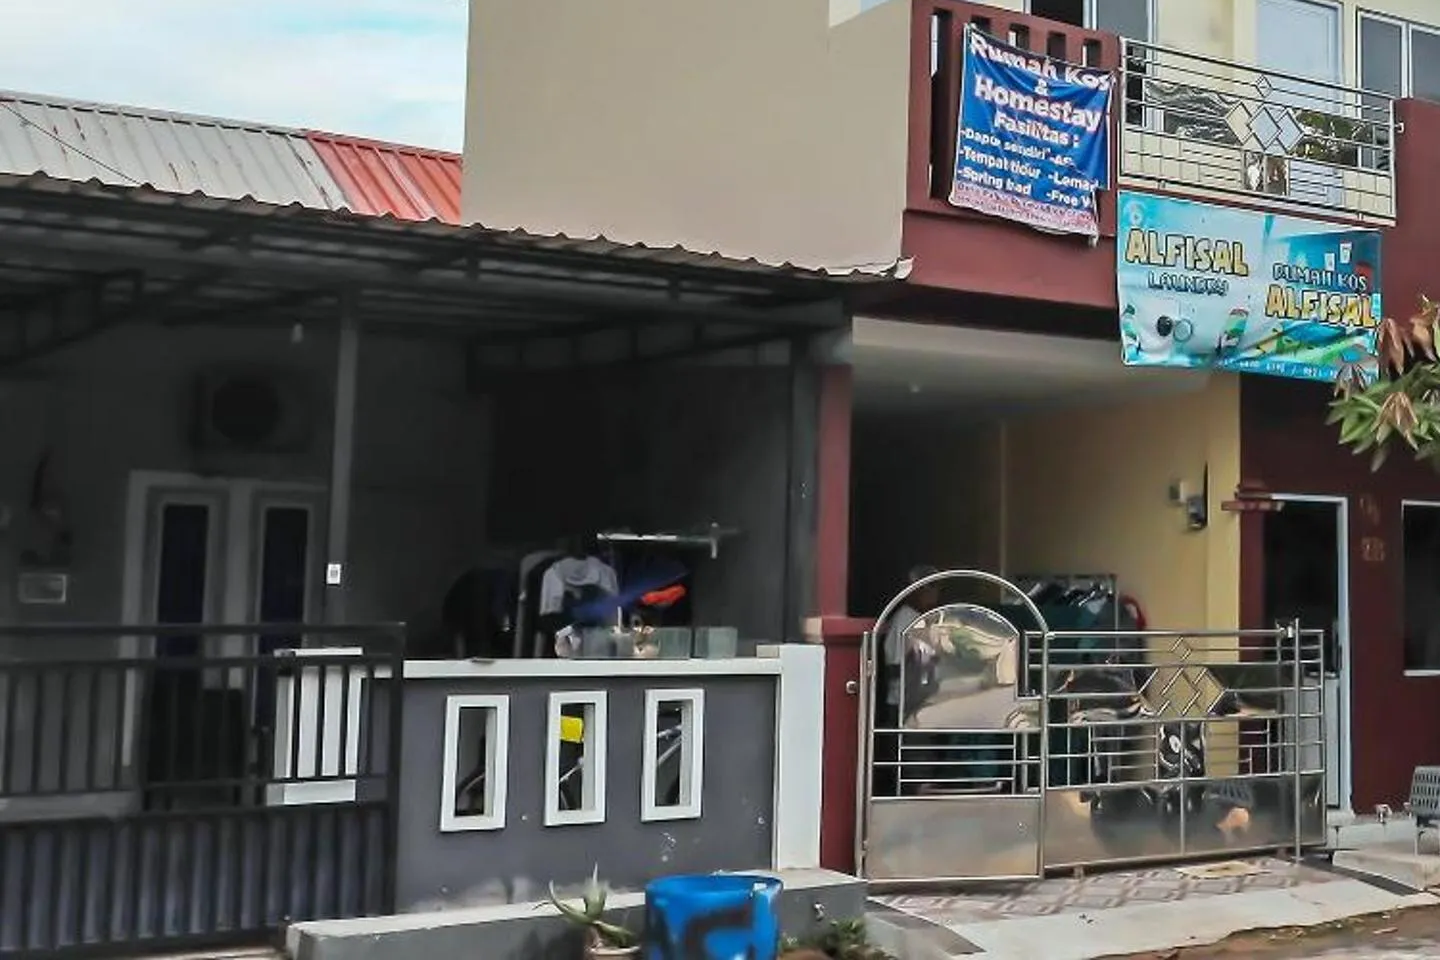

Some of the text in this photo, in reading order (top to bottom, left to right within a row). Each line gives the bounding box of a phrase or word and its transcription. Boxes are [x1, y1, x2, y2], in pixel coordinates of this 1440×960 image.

[975, 73, 1102, 133] Homestay
[1125, 228, 1249, 277] ALFISAL
[1272, 262, 1368, 292] RUMAH KOS
[1265, 283, 1378, 329] ALFISAL
